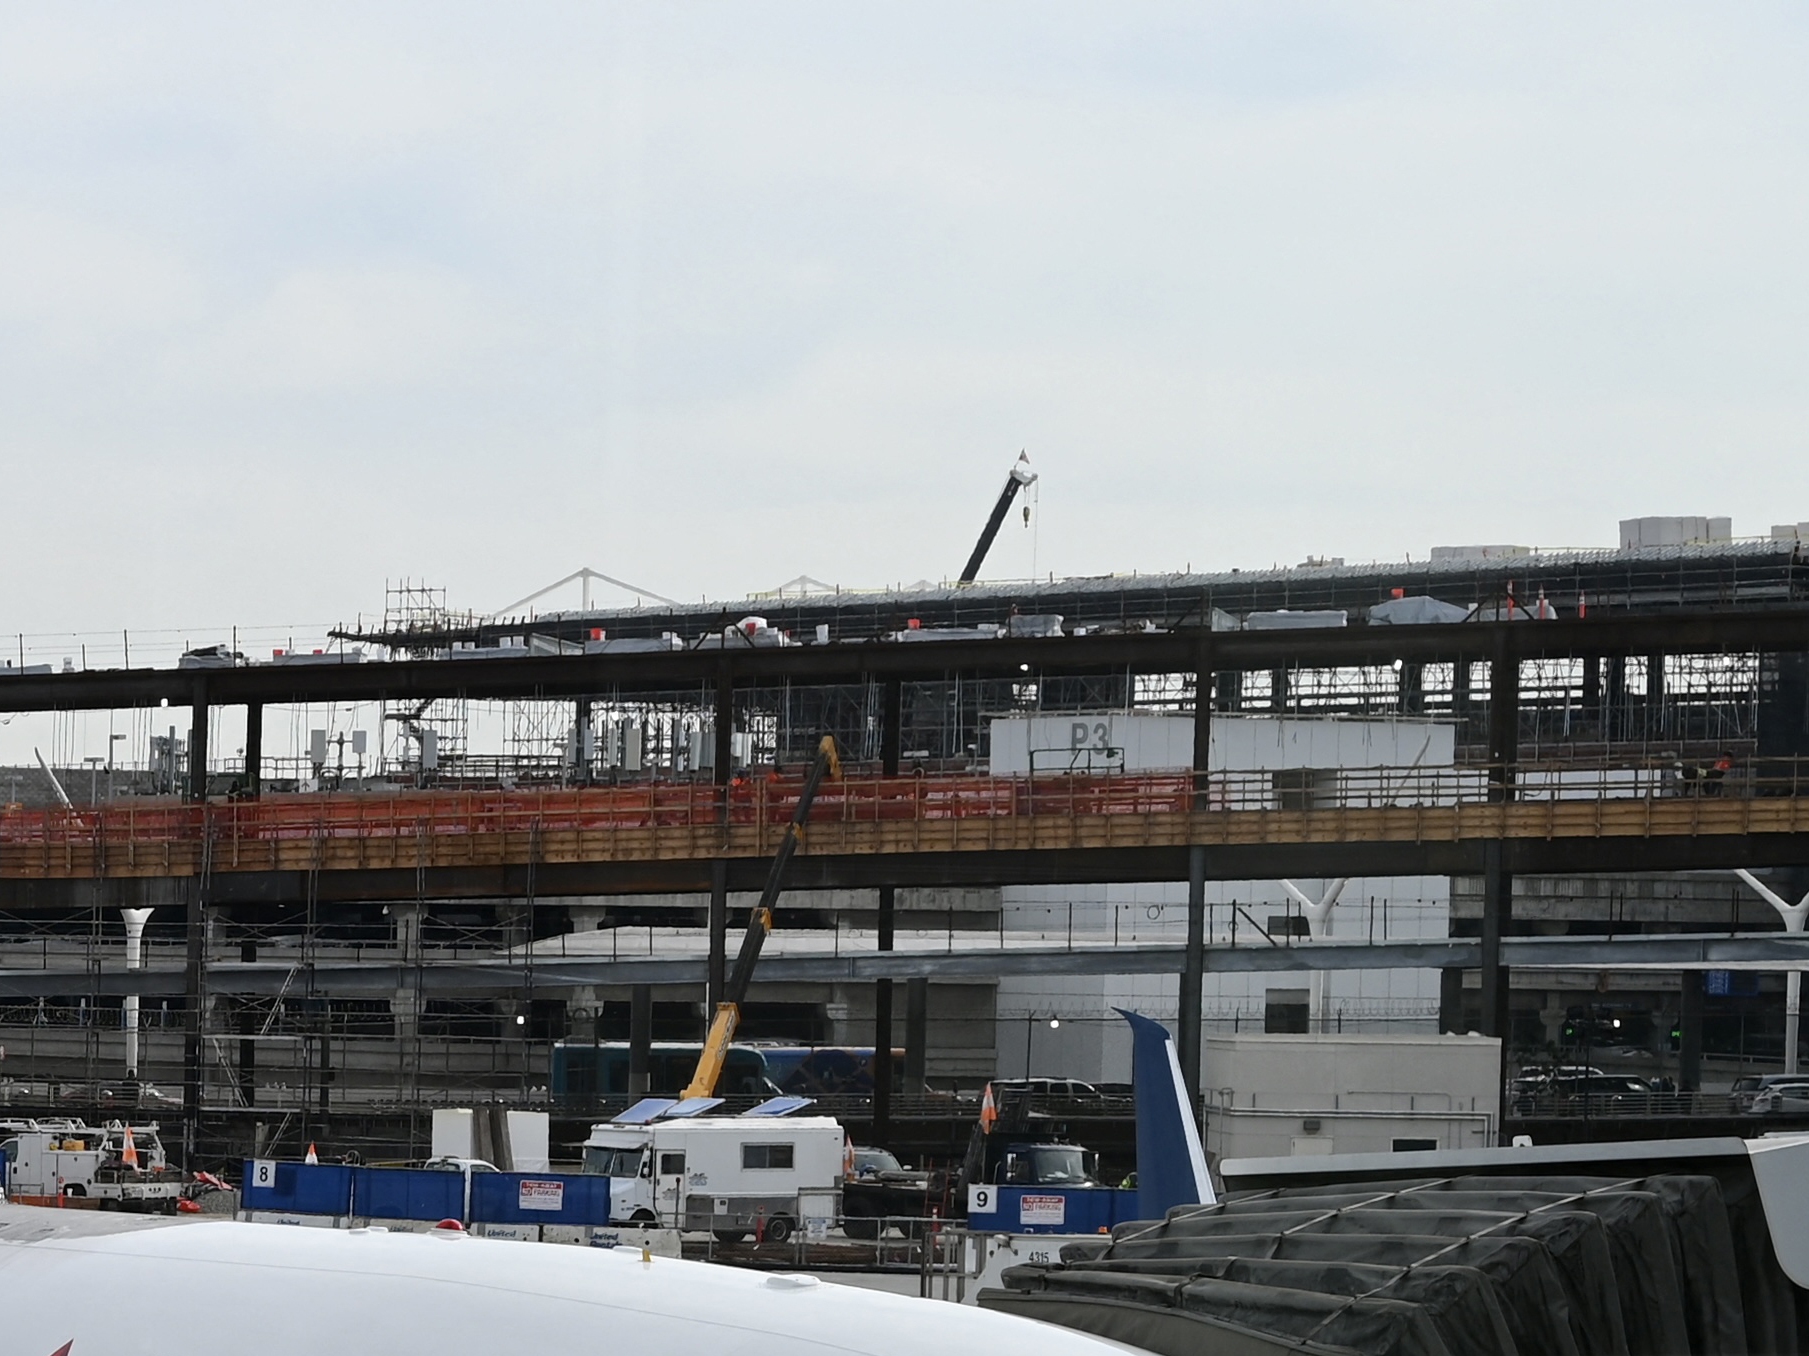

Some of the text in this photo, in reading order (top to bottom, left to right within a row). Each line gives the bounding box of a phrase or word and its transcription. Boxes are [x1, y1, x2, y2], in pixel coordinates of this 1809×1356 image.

[1071, 722, 1108, 756] P3
[259, 1166, 268, 1183] 8
[976, 1191, 988, 1208] 9
[1029, 1252, 1050, 1264] 4315
